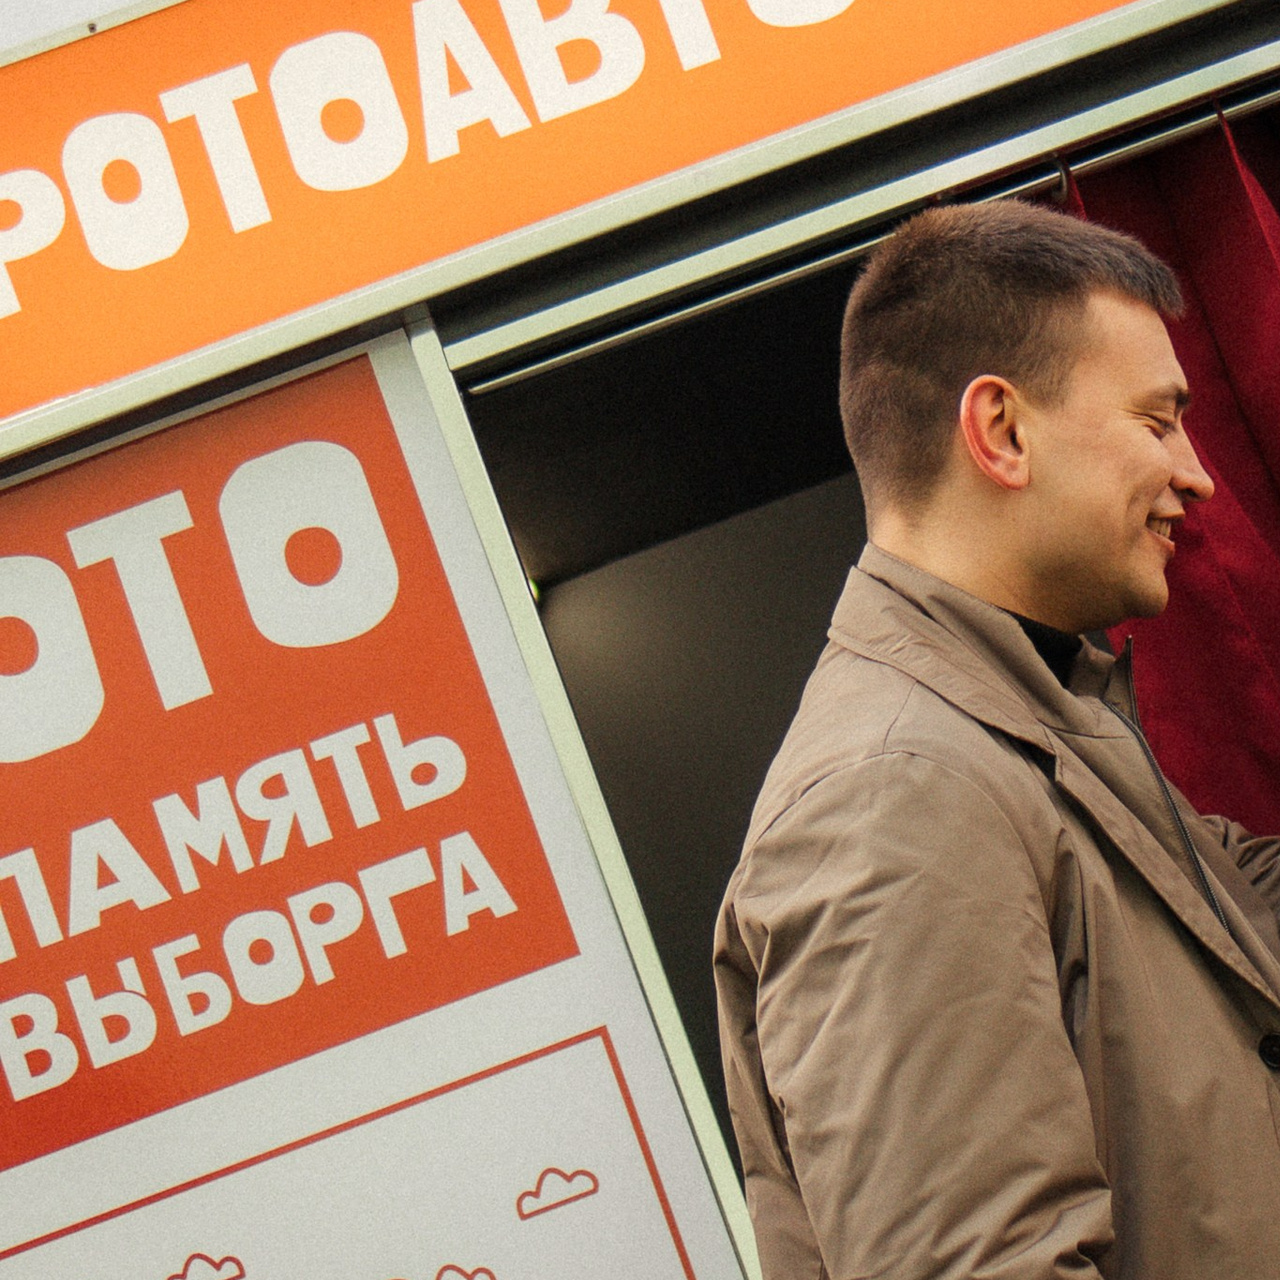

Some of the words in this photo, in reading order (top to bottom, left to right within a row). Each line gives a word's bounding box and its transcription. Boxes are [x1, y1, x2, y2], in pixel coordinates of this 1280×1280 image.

[0, 440, 400, 764] ОТО
[0, 713, 468, 964] ПАМЯТЬ
[0, 831, 519, 1102] ВЫБОРГА
